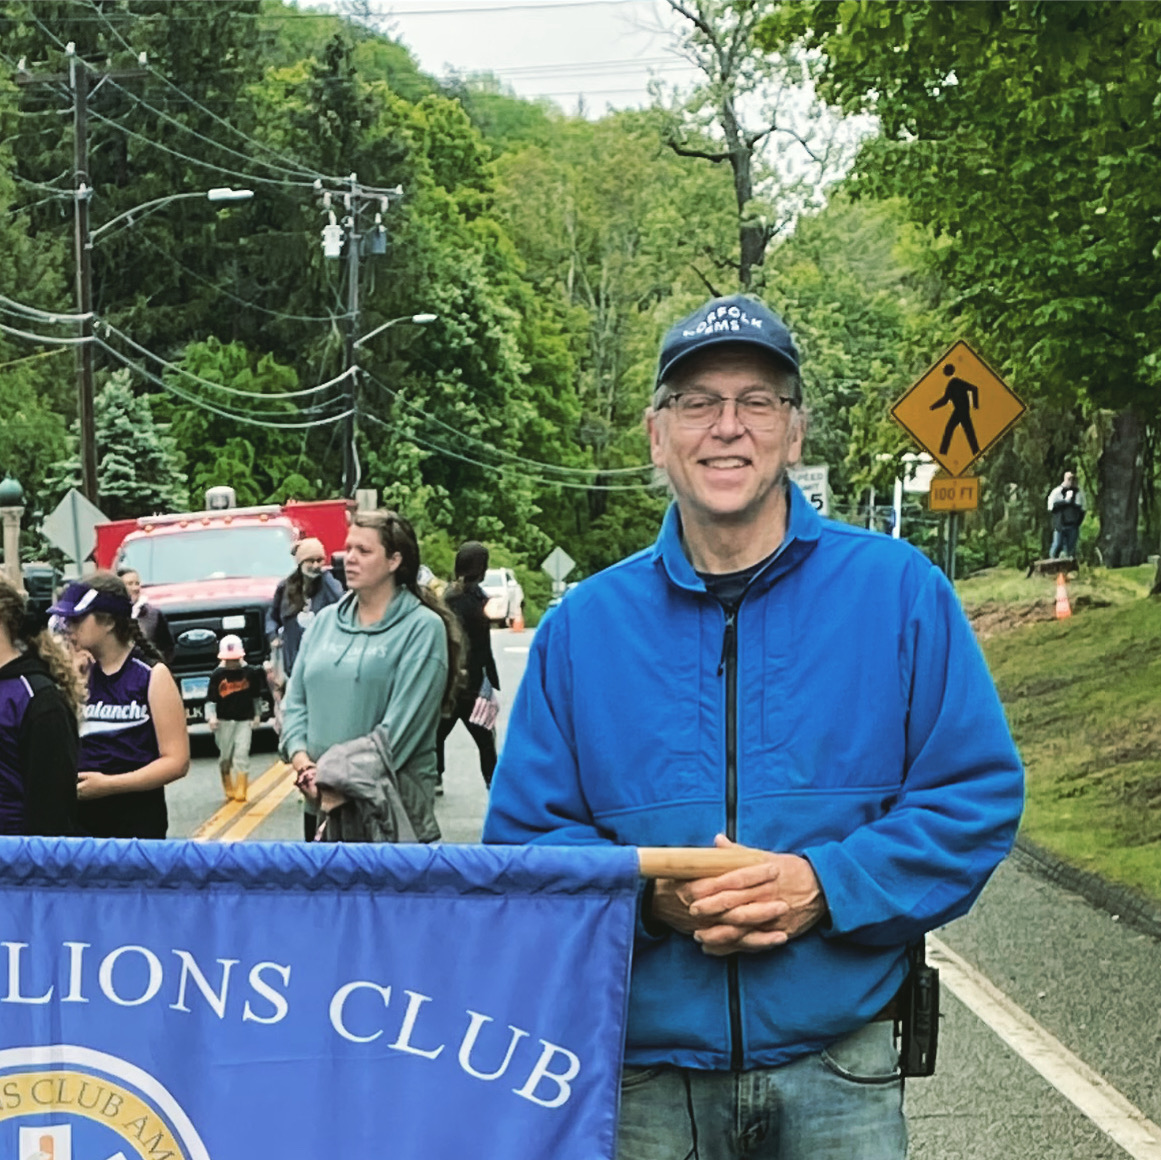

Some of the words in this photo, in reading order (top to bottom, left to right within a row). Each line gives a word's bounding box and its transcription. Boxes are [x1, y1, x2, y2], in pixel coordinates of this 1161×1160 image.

[810, 493, 824, 512] 5
[934, 487, 956, 501] 100
[959, 487, 975, 499] FT
[82, 700, 148, 719] alanche
[2, 942, 290, 1023] LIONS
[330, 982, 580, 1107] CLUB
[30, 1077, 125, 1119] CLUB
